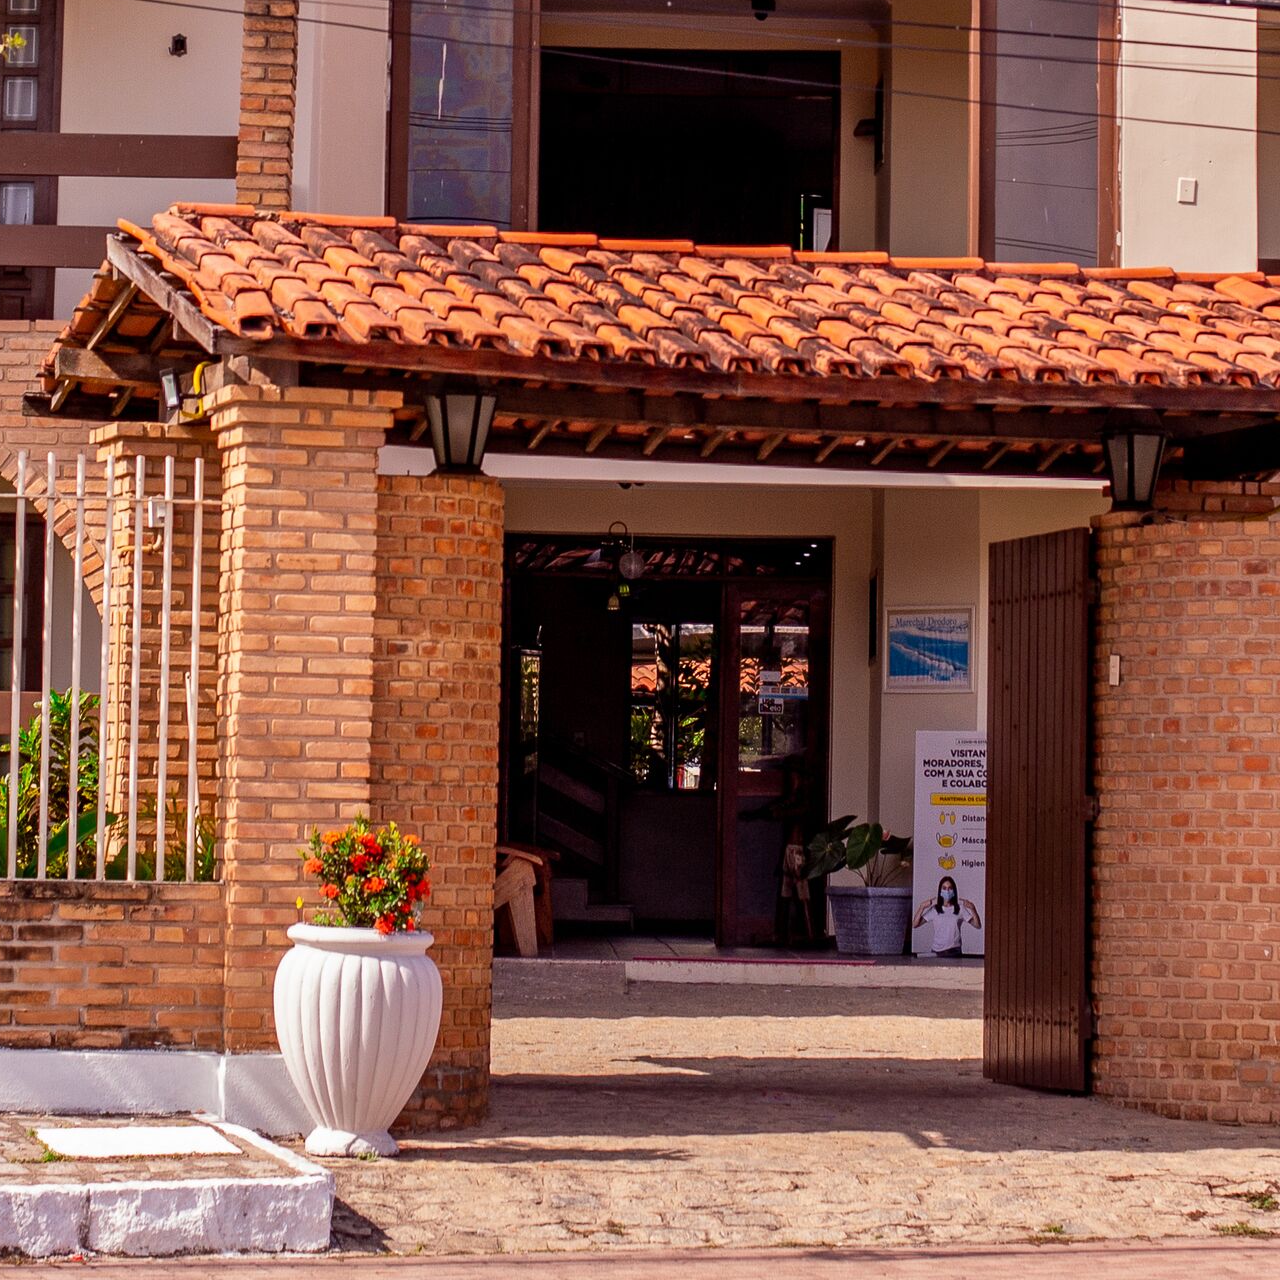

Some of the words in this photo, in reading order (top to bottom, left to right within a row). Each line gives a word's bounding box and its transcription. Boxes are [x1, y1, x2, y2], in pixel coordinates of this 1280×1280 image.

[896, 617, 926, 627] Marechal
[951, 749, 985, 757] VISITAN
[923, 760, 984, 768] MORADORES,
[924, 769, 945, 777] COM
[947, 769, 954, 777] A
[956, 769, 974, 777] SUA
[950, 780, 987, 788] COLABO
